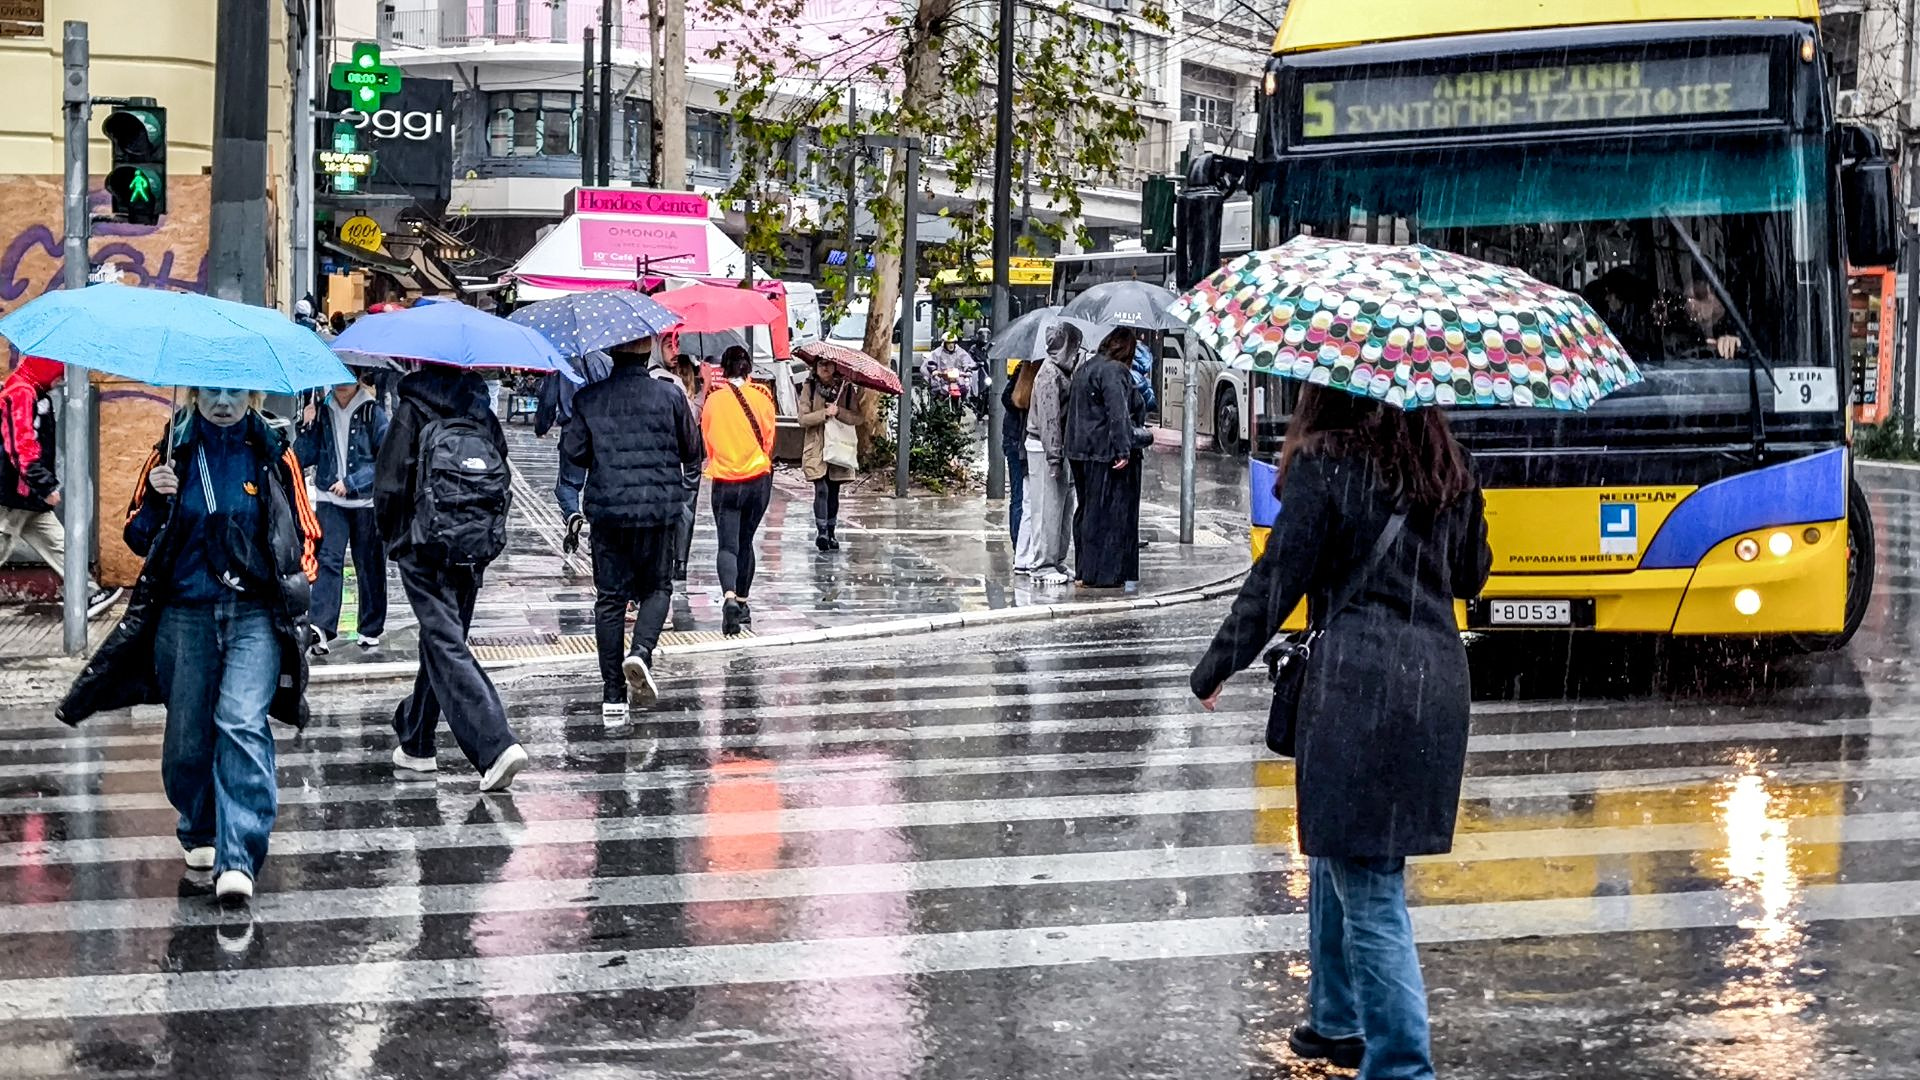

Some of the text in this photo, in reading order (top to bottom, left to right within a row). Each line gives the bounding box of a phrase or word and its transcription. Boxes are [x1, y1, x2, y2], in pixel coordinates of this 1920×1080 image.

[1302, 82, 1335, 138] 5
[579, 190, 704, 215] Hondos Center
[1789, 372, 1822, 381] ΣΕΙΡΑ
[1800, 383, 1812, 404] 9
[1599, 491, 1677, 502] NEOPLAN
[1509, 554, 1578, 564] PAPADAKIS
[1504, 604, 1557, 620] 8053
